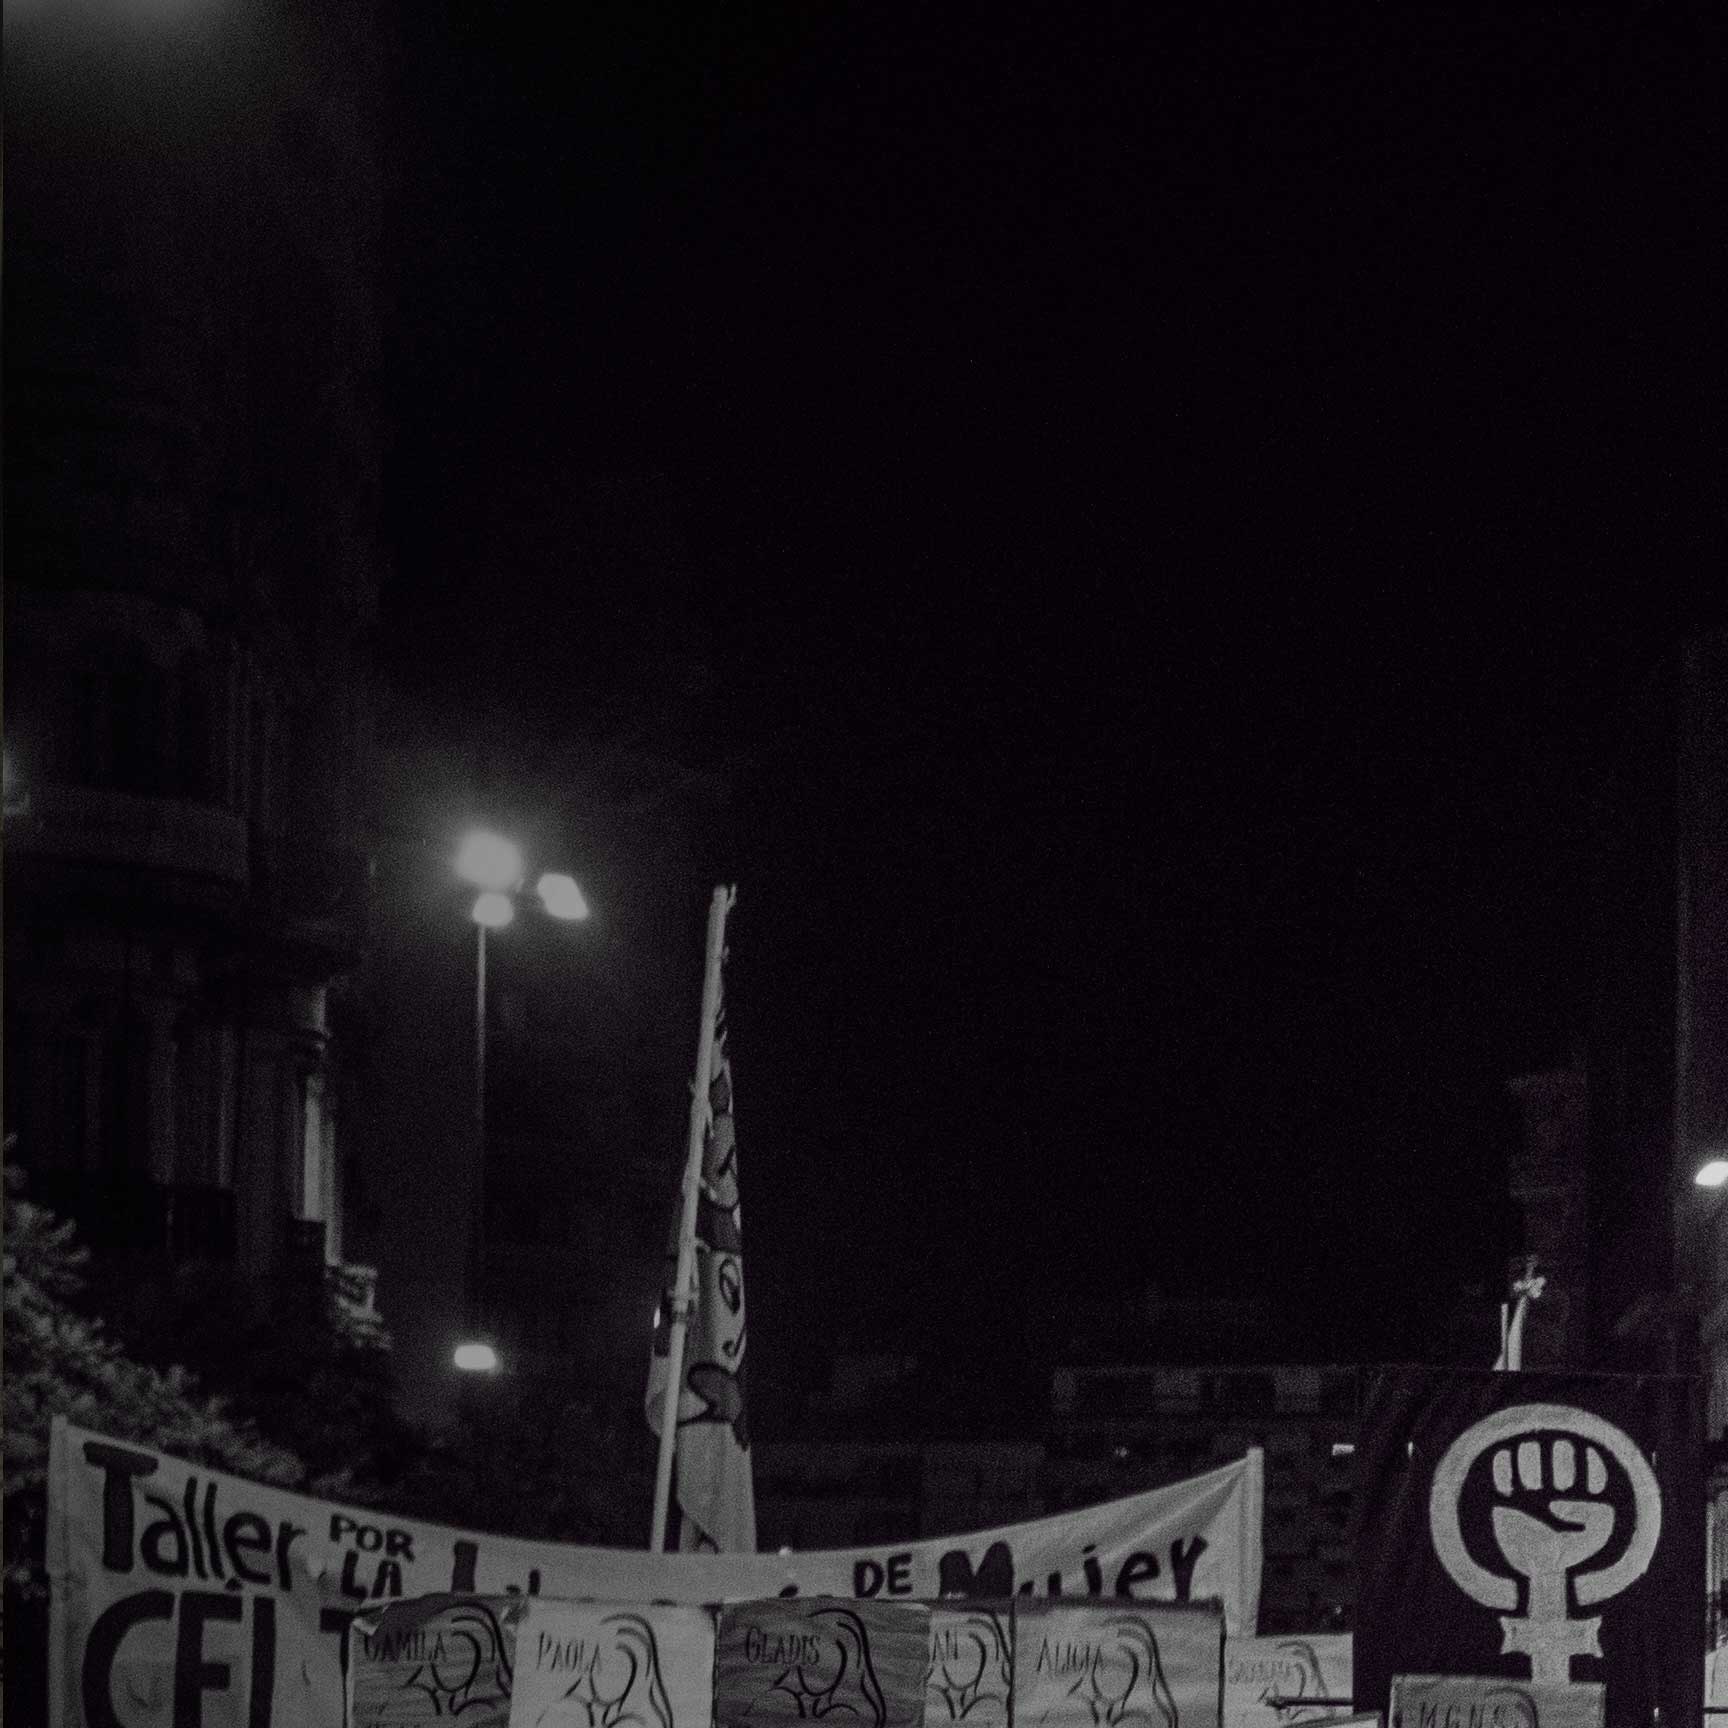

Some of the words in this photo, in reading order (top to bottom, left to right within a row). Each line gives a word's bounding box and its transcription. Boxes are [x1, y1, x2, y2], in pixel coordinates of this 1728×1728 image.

[82, 1441, 307, 1592] Taller
[330, 1514, 415, 1562] POR
[341, 1550, 402, 1597] LA
[853, 1553, 914, 1598] DE
[535, 1631, 602, 1672] PAOLA
[929, 1628, 960, 1662] AN
